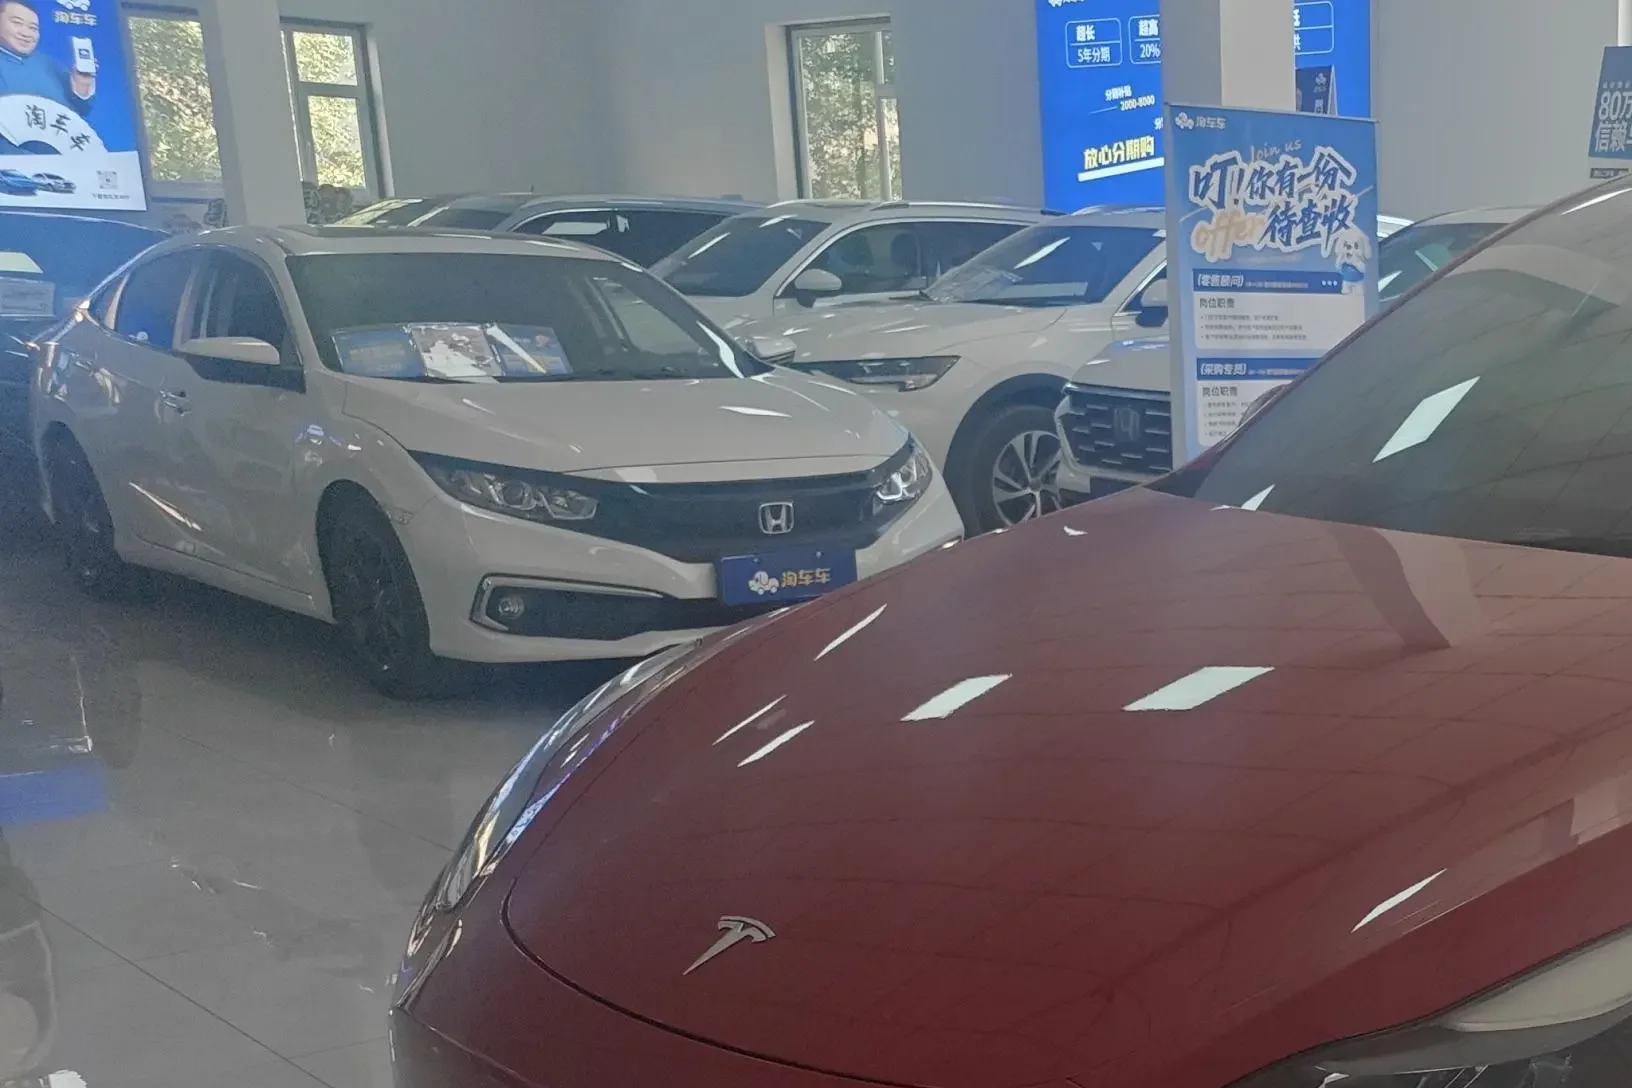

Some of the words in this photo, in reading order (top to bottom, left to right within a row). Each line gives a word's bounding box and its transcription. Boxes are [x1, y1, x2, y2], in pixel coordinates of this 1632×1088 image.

[1077, 45, 1111, 63] 5年分期
[25, 103, 91, 151] 淘车车
[1083, 134, 1155, 170] 放心分期购
[1257, 194, 1352, 252] 待查收
[781, 567, 832, 588] 淘车车
